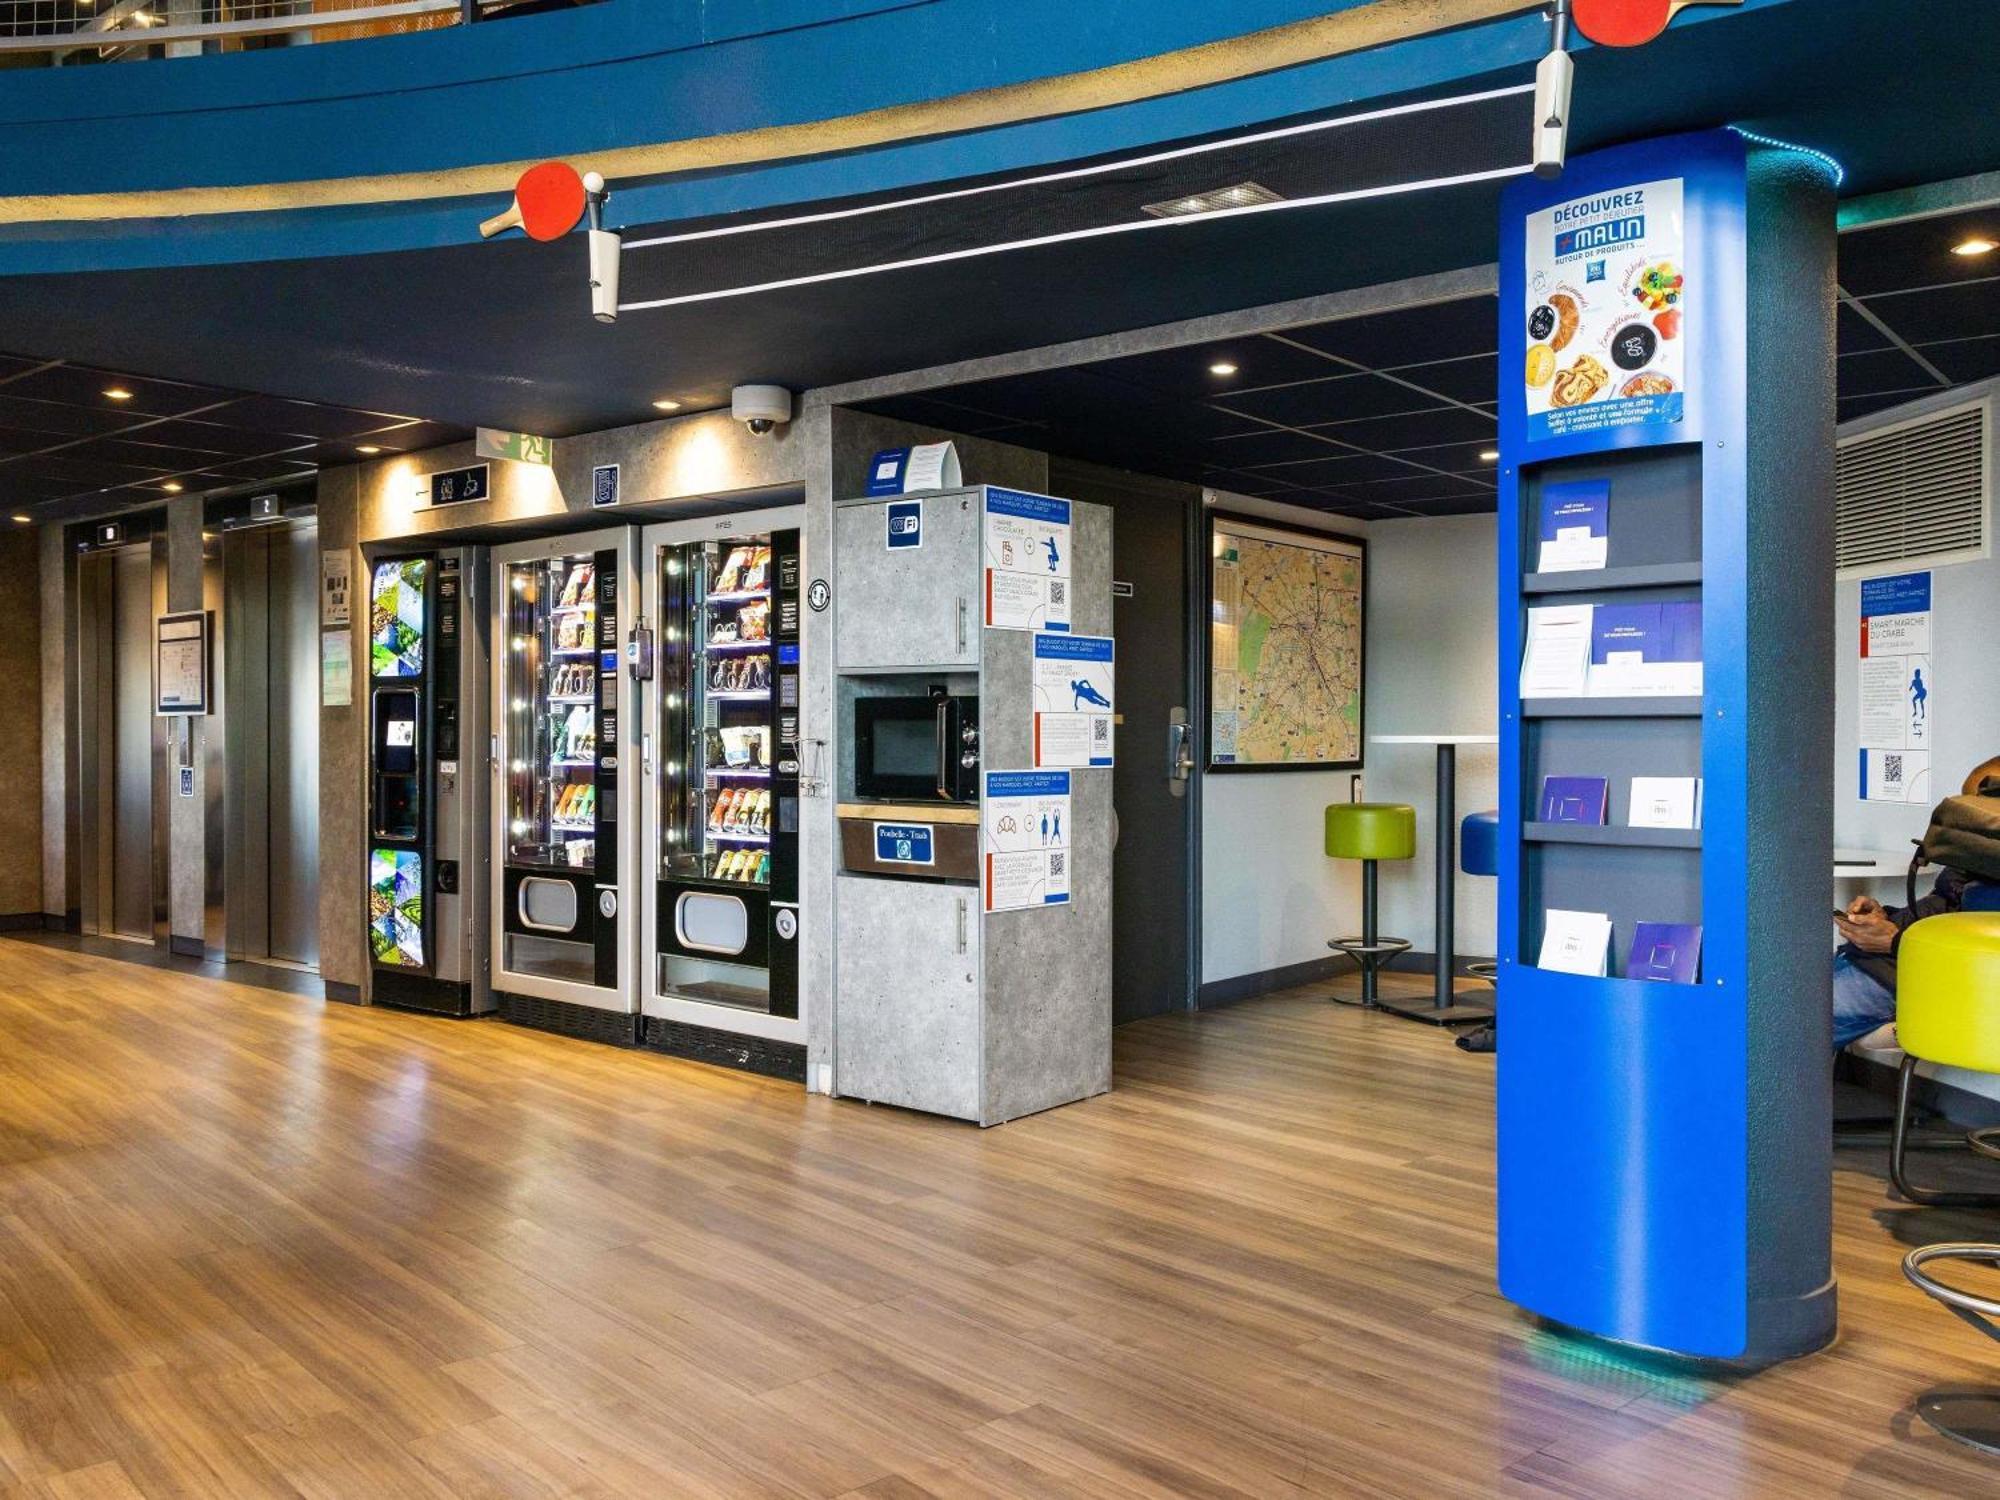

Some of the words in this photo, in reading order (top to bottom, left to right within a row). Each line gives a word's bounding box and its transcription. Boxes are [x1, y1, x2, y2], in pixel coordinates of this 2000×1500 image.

[1554, 190, 1644, 224] DÉCOUVREZ
[1579, 213, 1601, 227] PETIT
[1575, 219, 1641, 249] MALIN
[1555, 253, 1584, 266] AUTOUR
[1585, 250, 1594, 258] DE
[1596, 242, 1635, 255] PRODUITS
[1547, 412, 1565, 421] Selon
[1565, 410, 1577, 418] vos
[1578, 405, 1600, 415] envies
[1601, 403, 1618, 412] avec
[1619, 401, 1634, 409] une
[1635, 398, 1654, 407] offre
[1599, 411, 1607, 419] et
[1623, 406, 1653, 417] formule
[1571, 420, 1602, 431] croissant
[1870, 631, 1880, 640] DU
[1882, 628, 1905, 639] CRABE
